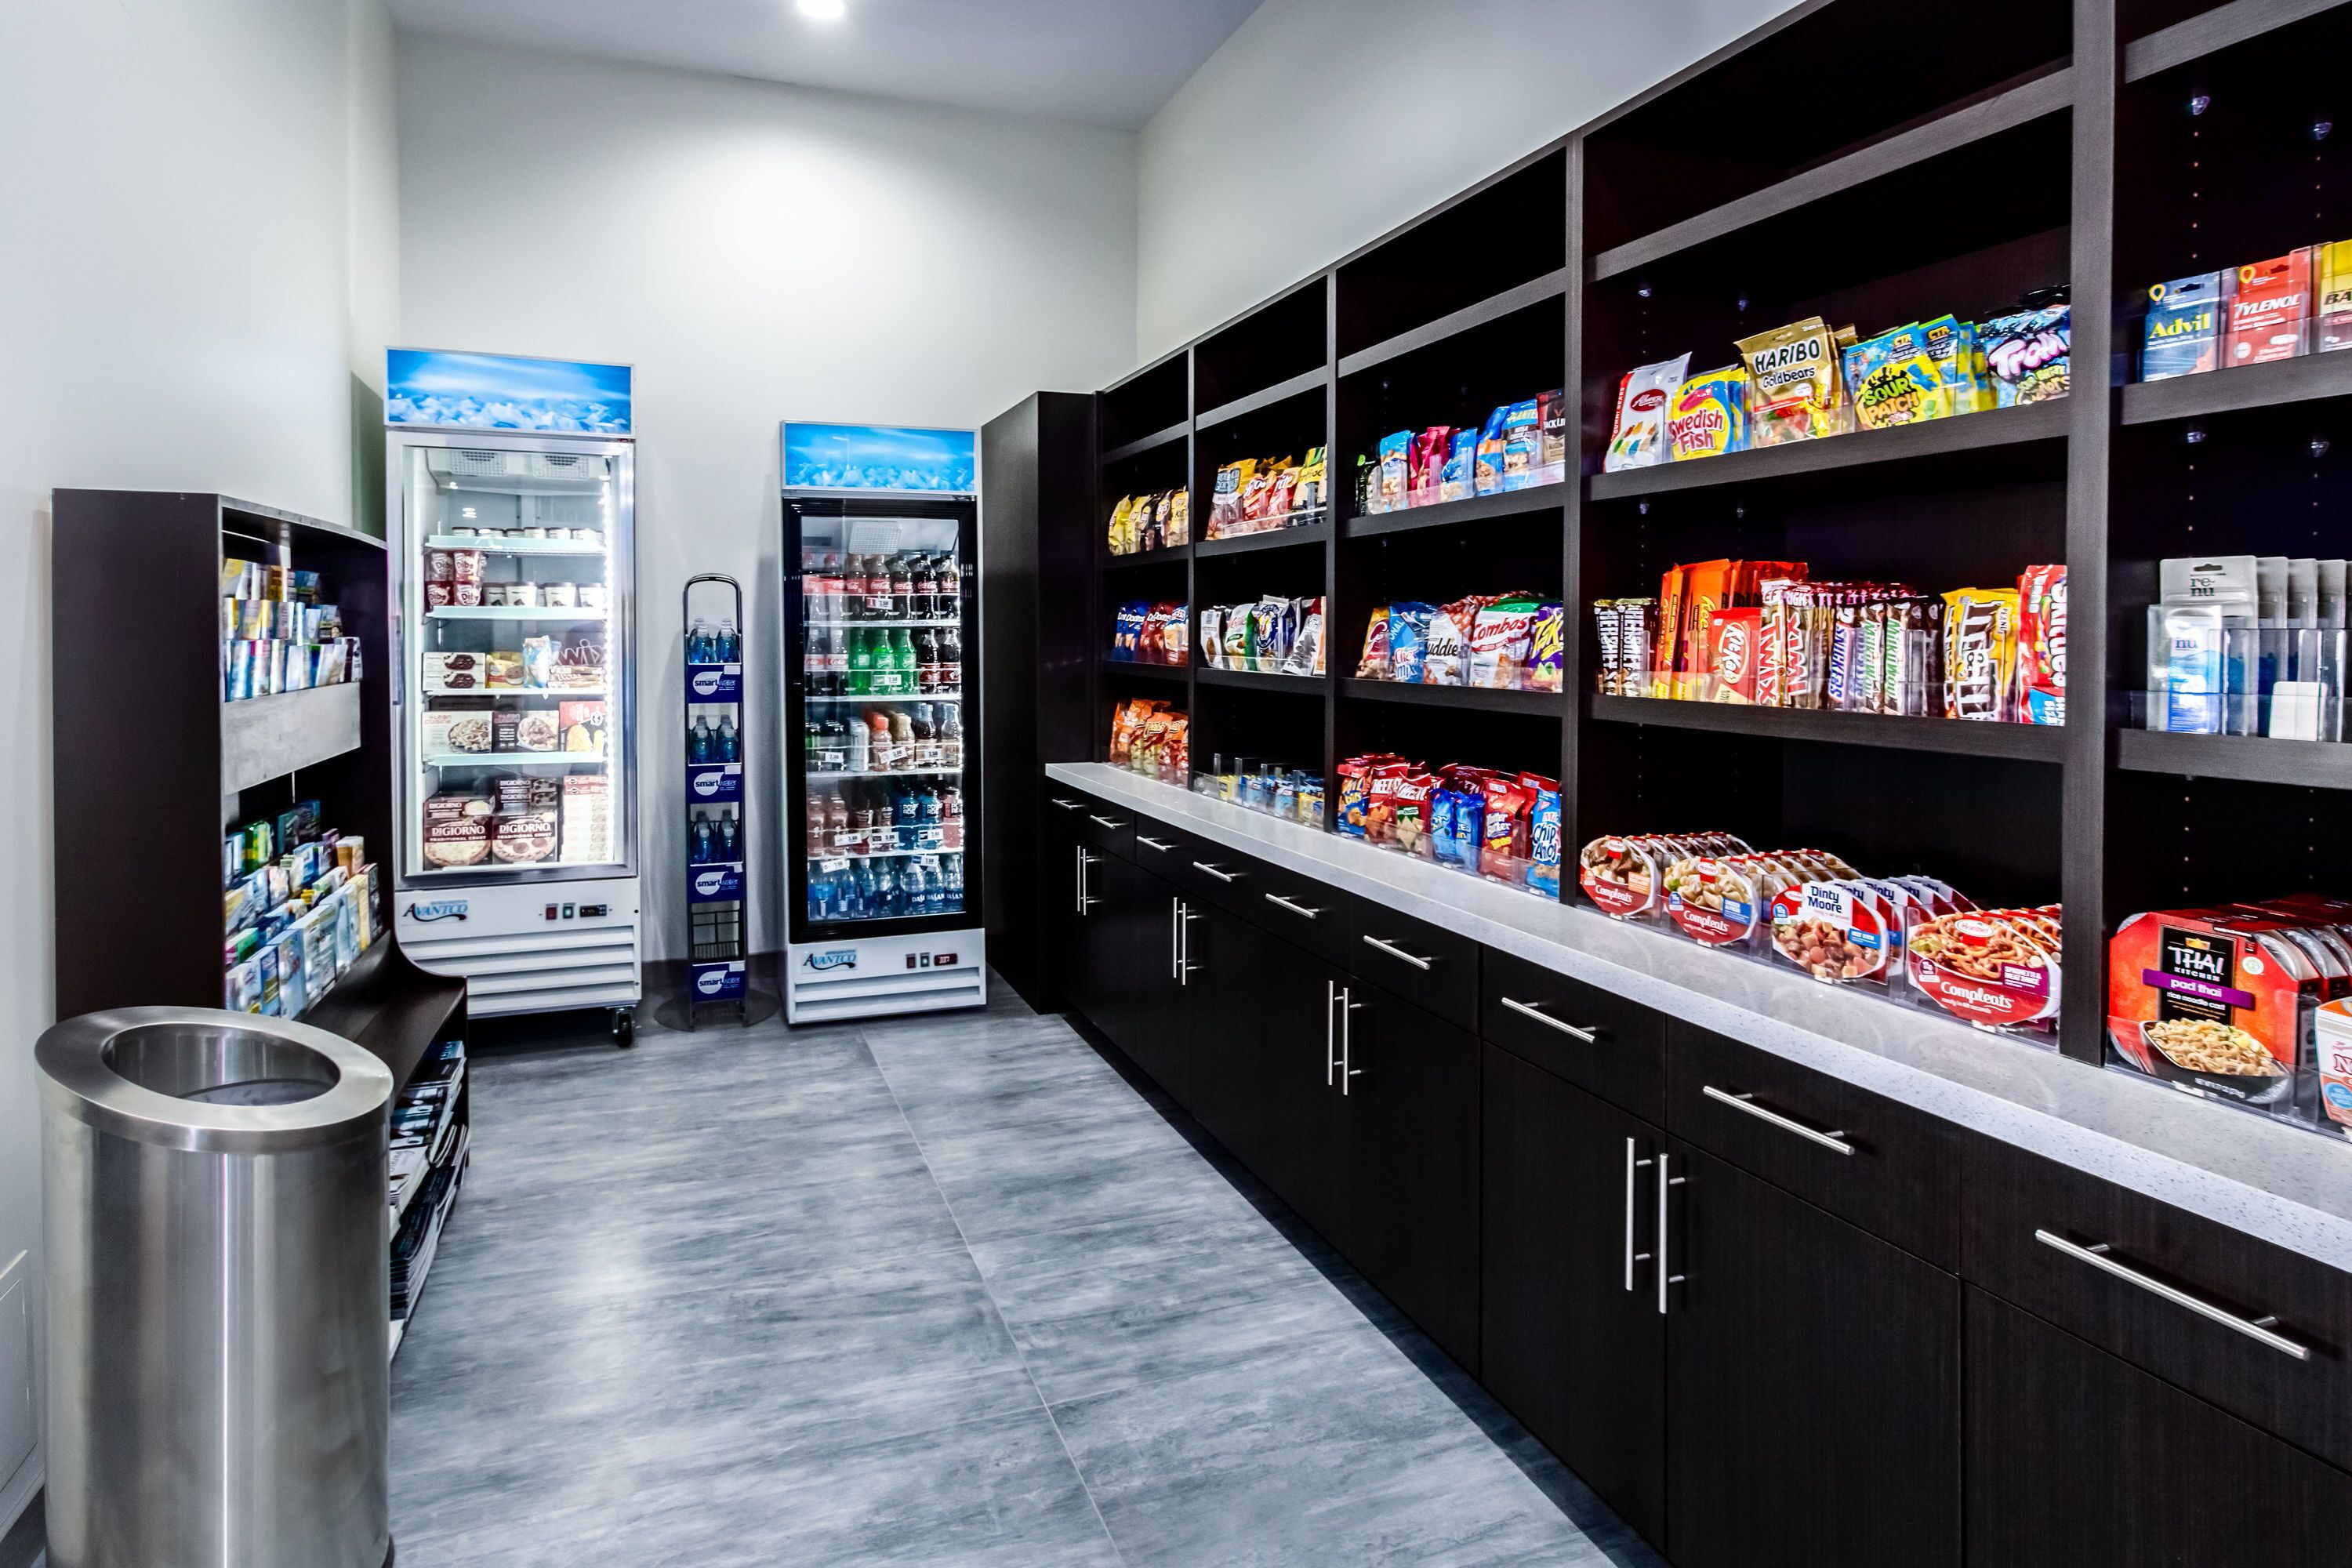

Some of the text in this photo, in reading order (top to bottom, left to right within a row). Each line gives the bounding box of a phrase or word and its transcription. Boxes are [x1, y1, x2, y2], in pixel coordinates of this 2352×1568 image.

[2234, 294, 2302, 320] TYLENOL
[2149, 313, 2211, 339] Advil
[1755, 339, 1820, 374] HARIBO
[1763, 367, 1815, 389] Goldbears
[1864, 377, 1910, 406] SOUR
[1865, 392, 1919, 423] PATCH
[1668, 408, 1722, 444] Swedish
[1678, 428, 1715, 456] Fish
[2190, 587, 2215, 597] nu
[1468, 616, 1529, 642] Combos
[1724, 624, 1744, 653] Kit
[1830, 626, 1846, 697] SNICKERS
[432, 826, 485, 837] DIGIORNO
[499, 823, 551, 834] DIGIORNO
[1595, 884, 1634, 903] Compleats
[1808, 895, 1842, 913] Moore
[1811, 885, 1839, 903] Dinty
[402, 902, 468, 922] AVANTCO
[1682, 909, 1730, 932] Compleats
[803, 953, 856, 969] AVANTCO
[2168, 946, 2225, 975] THAI
[2174, 967, 2221, 982] KITCHEN
[1940, 981, 2015, 1010] Compleats
[2166, 991, 2181, 1000] rice
[2181, 995, 2209, 1007] noodle
[2170, 979, 2223, 998] pad thai
